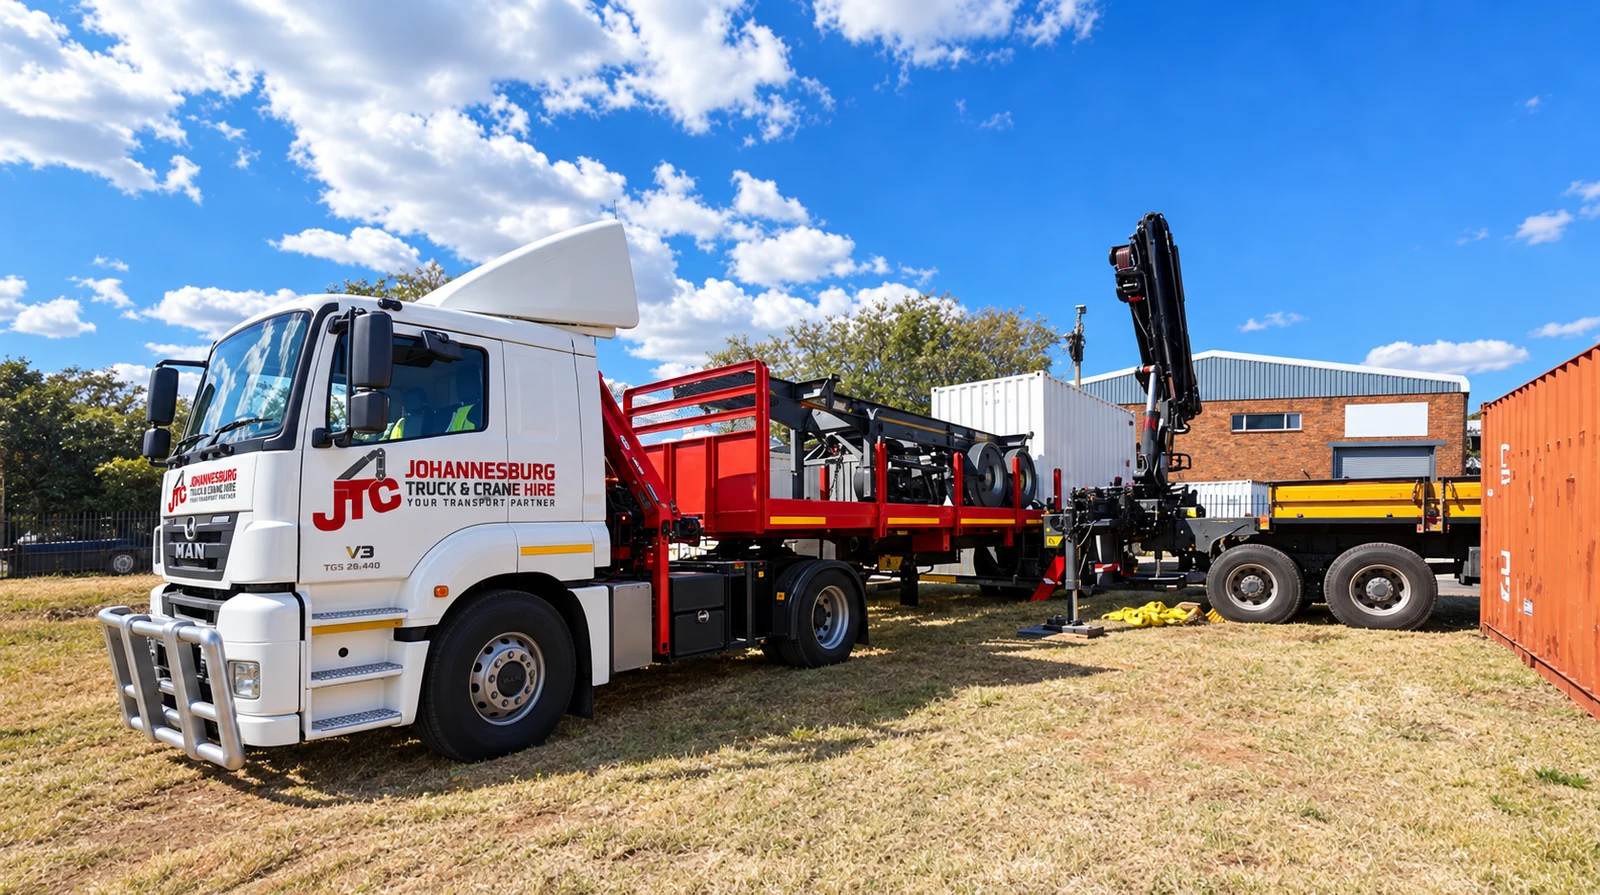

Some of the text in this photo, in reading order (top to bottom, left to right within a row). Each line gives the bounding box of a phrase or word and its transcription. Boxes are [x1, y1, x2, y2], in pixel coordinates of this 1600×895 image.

[190, 468, 237, 487] JOHANNESBURG
[405, 459, 556, 480] JOHANNESBURG
[405, 481, 556, 497] TRUCK & CRANE HIRE
[168, 485, 187, 513] JTC
[312, 476, 402, 532] JTC
[407, 498, 556, 507] YOUR TRANSPORT PARTNER
[175, 542, 205, 560] MAN
[345, 545, 375, 559] V3
[323, 563, 344, 571] TGS
